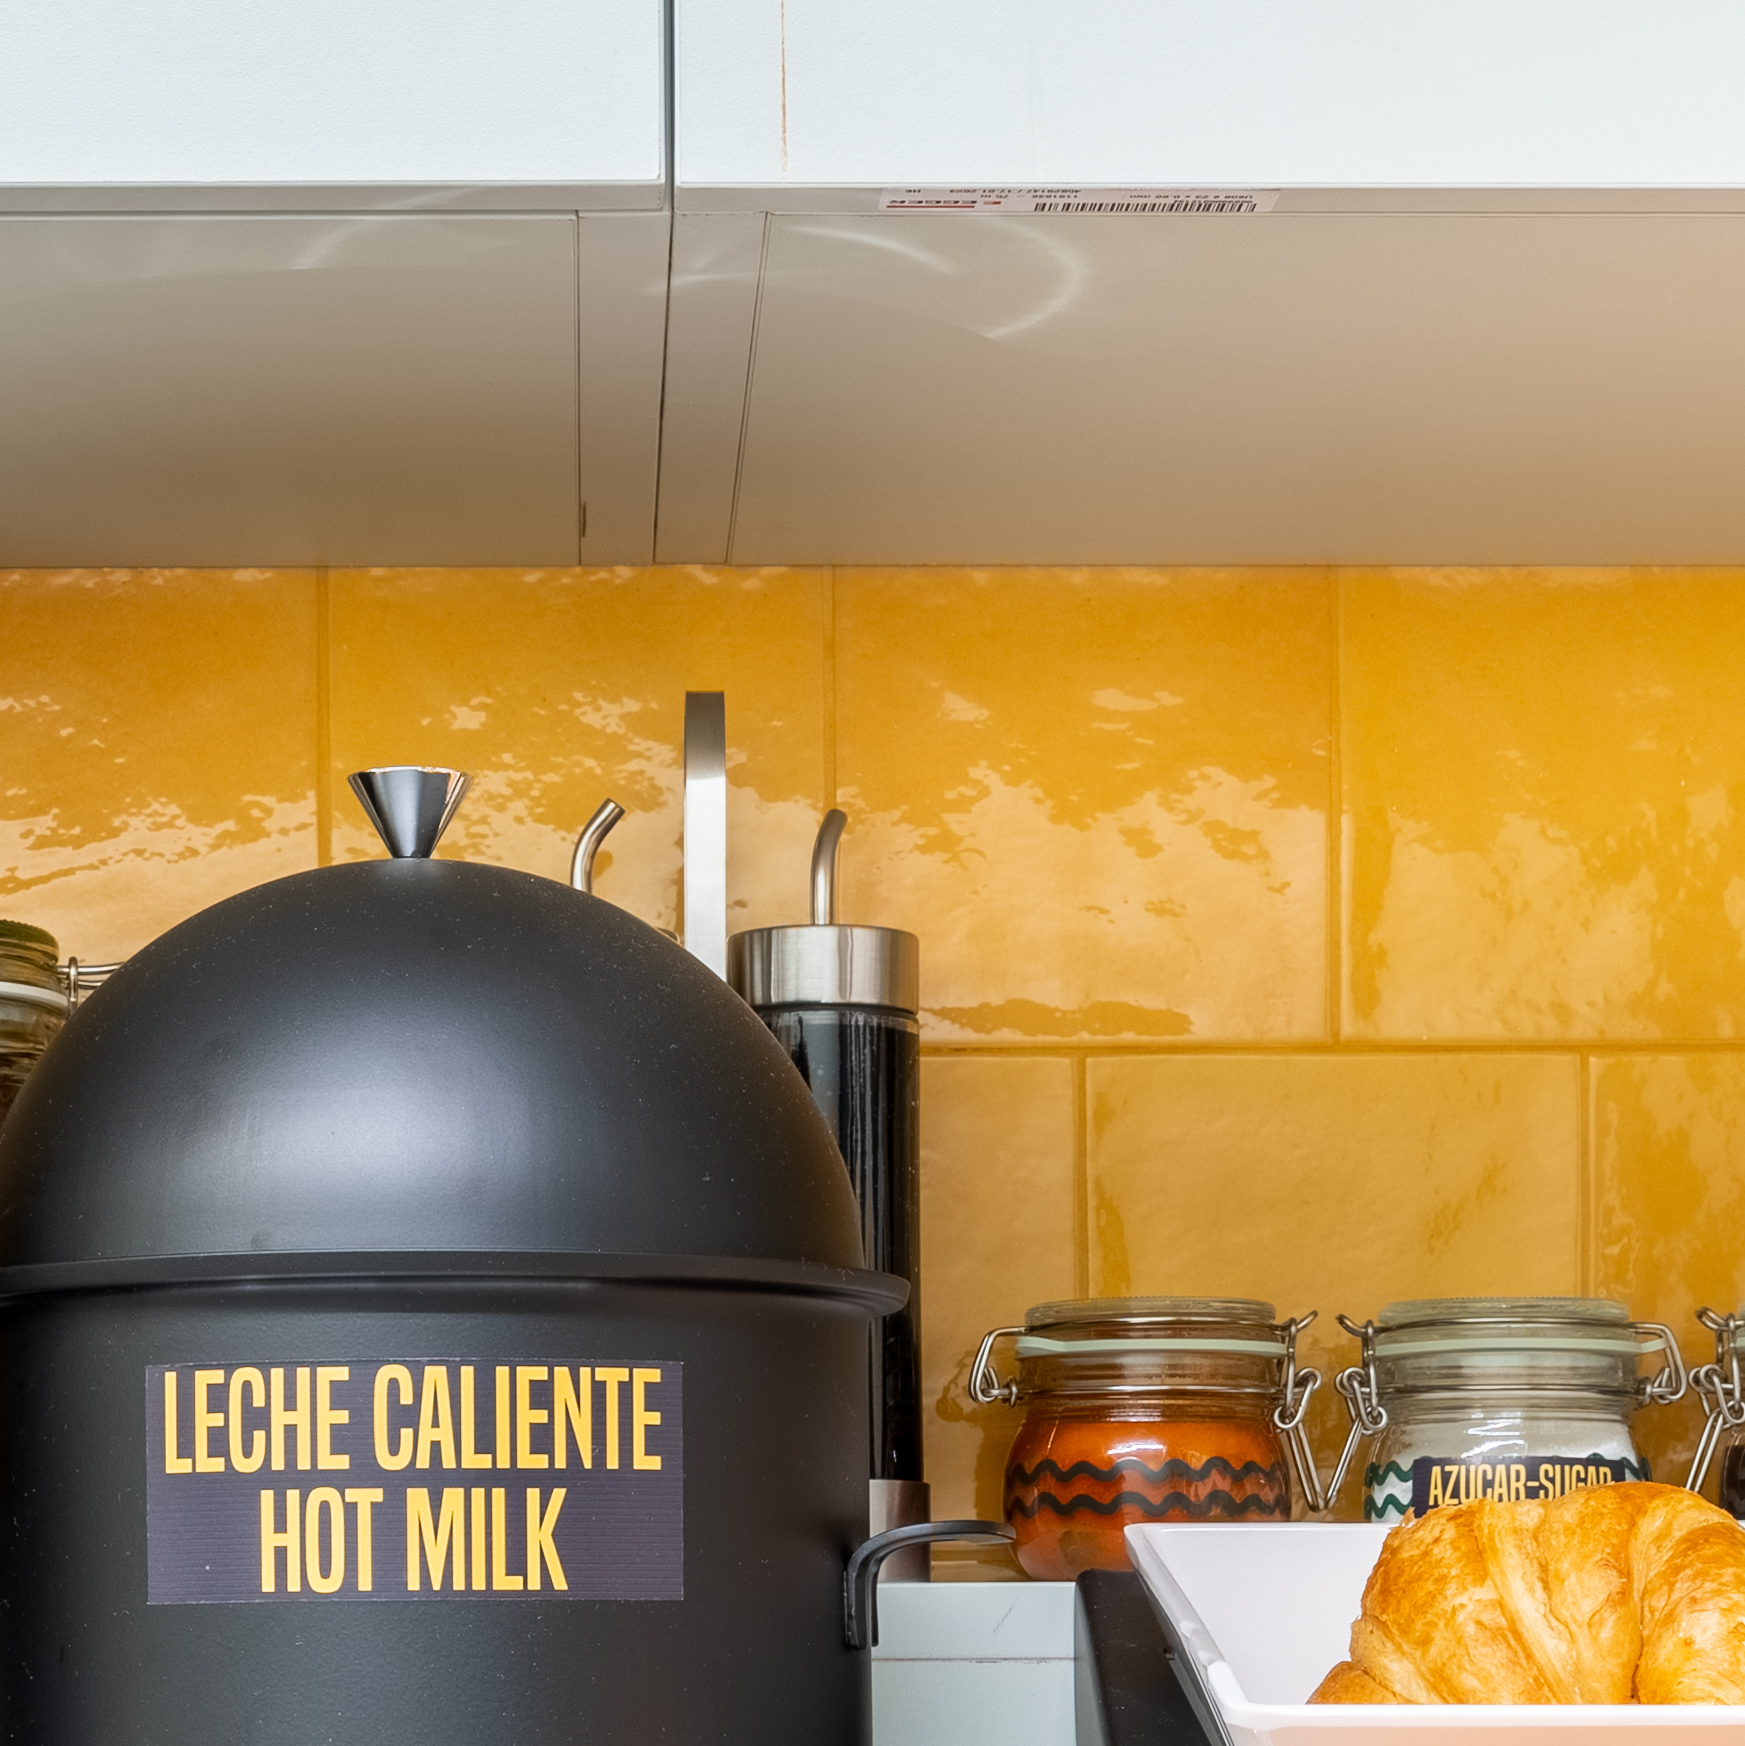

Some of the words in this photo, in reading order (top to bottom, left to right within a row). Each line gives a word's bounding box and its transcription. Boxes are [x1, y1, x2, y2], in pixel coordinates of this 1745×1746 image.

[163, 1365, 351, 1474] LECHE
[372, 1363, 662, 1471] CALIENTE
[259, 1486, 385, 1594] HOT
[405, 1487, 569, 1592] MILK
